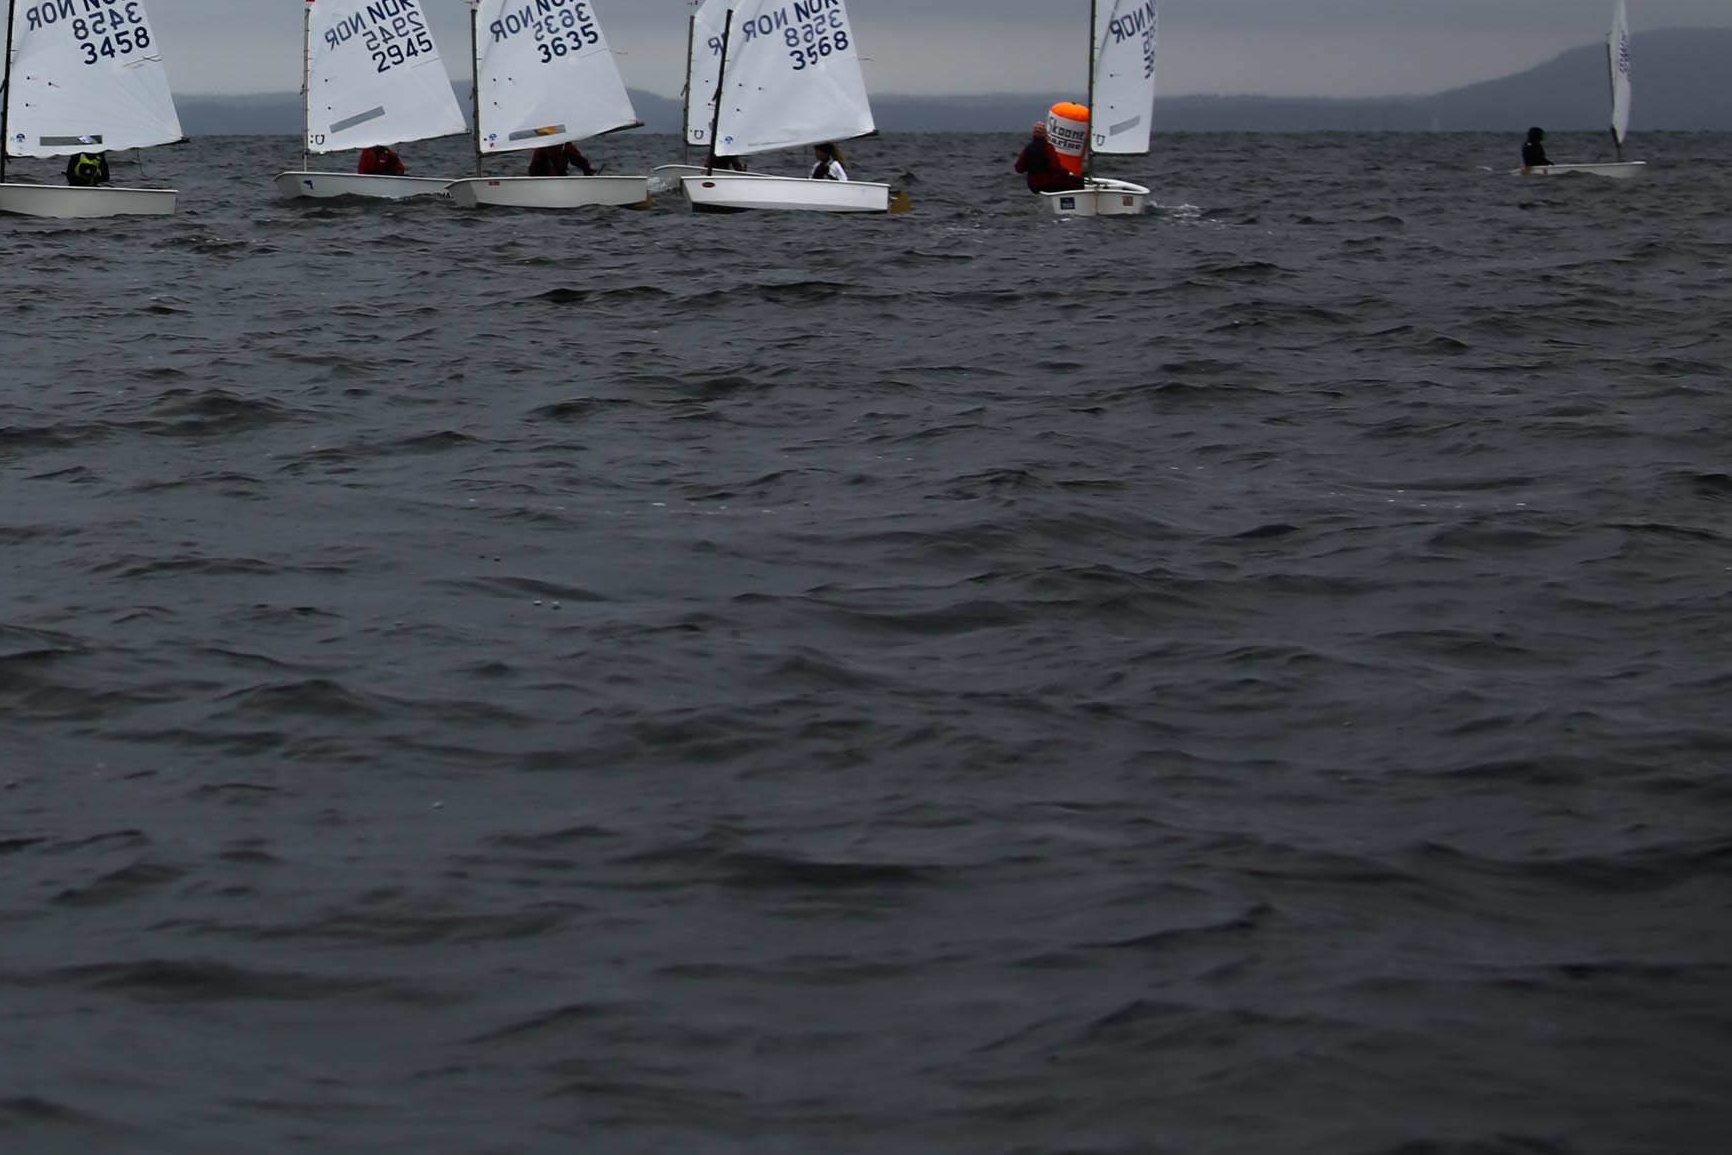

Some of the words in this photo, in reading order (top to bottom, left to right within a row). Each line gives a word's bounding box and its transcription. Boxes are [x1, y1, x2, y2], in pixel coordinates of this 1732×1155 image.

[80, 26, 150, 65] 3458
[372, 31, 433, 73] 2945
[537, 23, 599, 63] 3635
[789, 30, 849, 70] 3568
